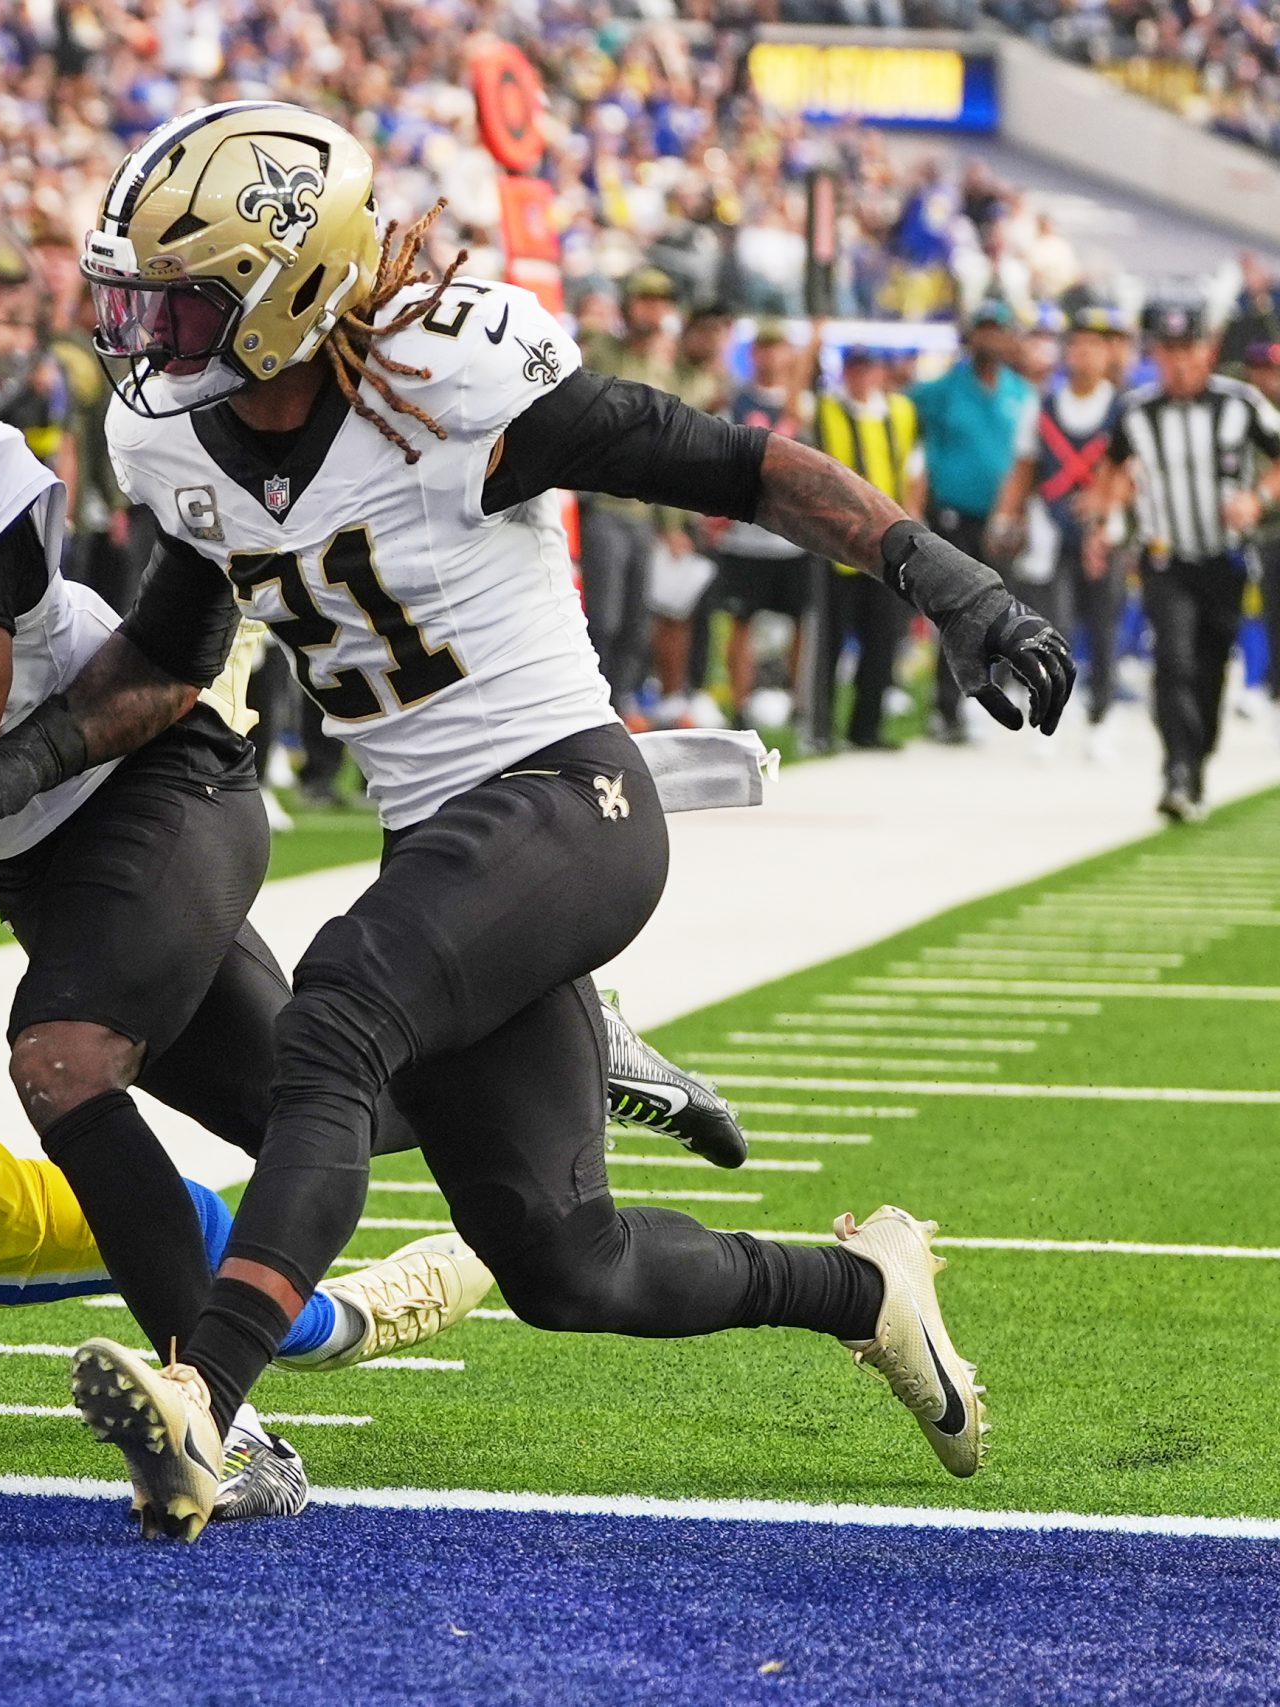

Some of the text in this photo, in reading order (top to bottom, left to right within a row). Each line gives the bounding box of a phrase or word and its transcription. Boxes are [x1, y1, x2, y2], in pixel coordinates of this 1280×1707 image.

[177, 489, 215, 528] C
[267, 491, 286, 507] NFL
[227, 522, 470, 724] 21
